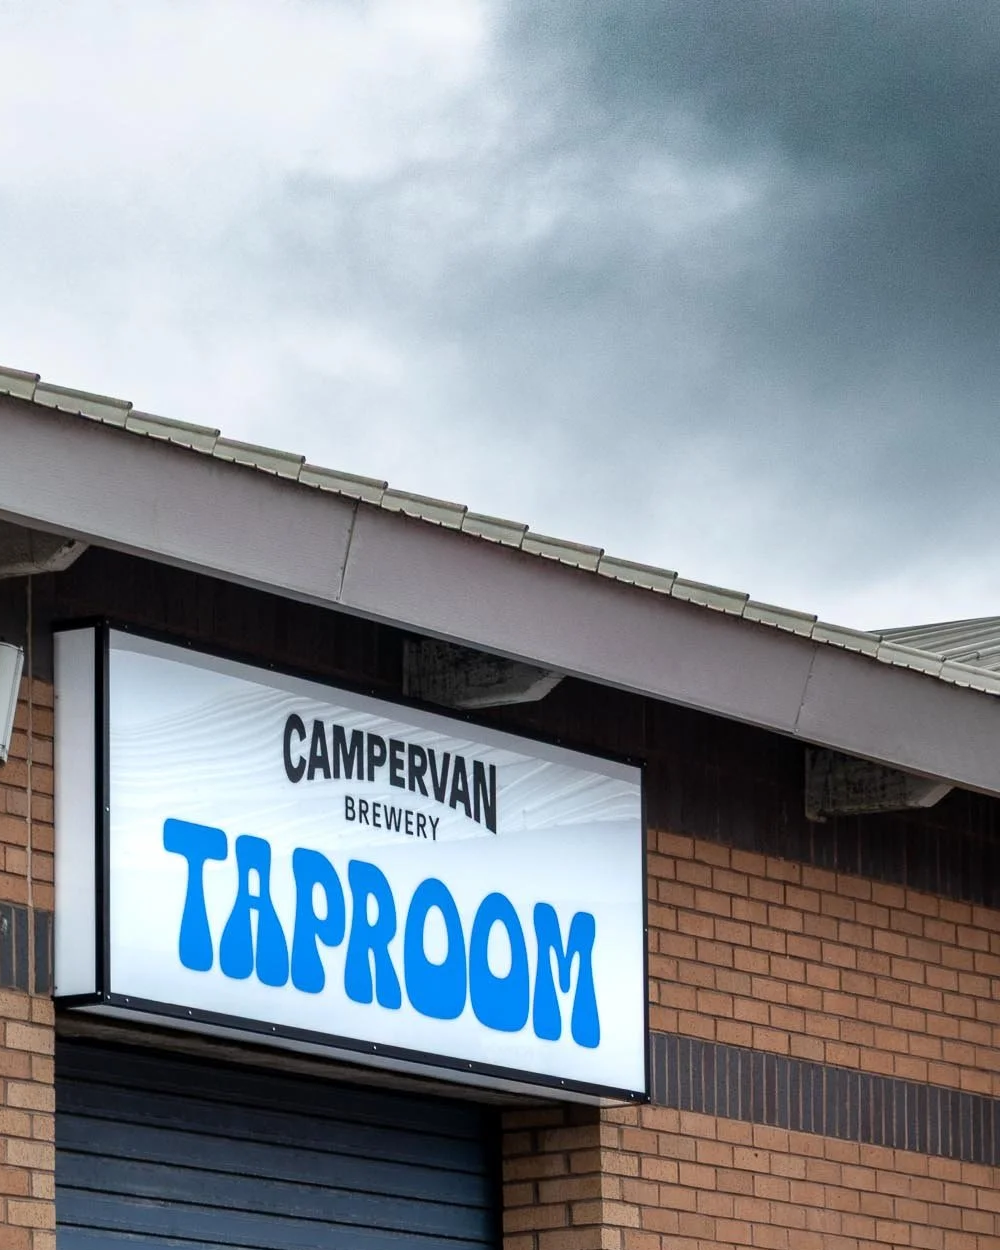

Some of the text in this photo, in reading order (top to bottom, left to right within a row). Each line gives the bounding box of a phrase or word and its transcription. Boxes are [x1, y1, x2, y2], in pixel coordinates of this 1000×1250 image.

[282, 713, 498, 835] CAMPERVAN
[344, 795, 441, 841] BREWERY
[162, 817, 601, 1050] TAPROOM
